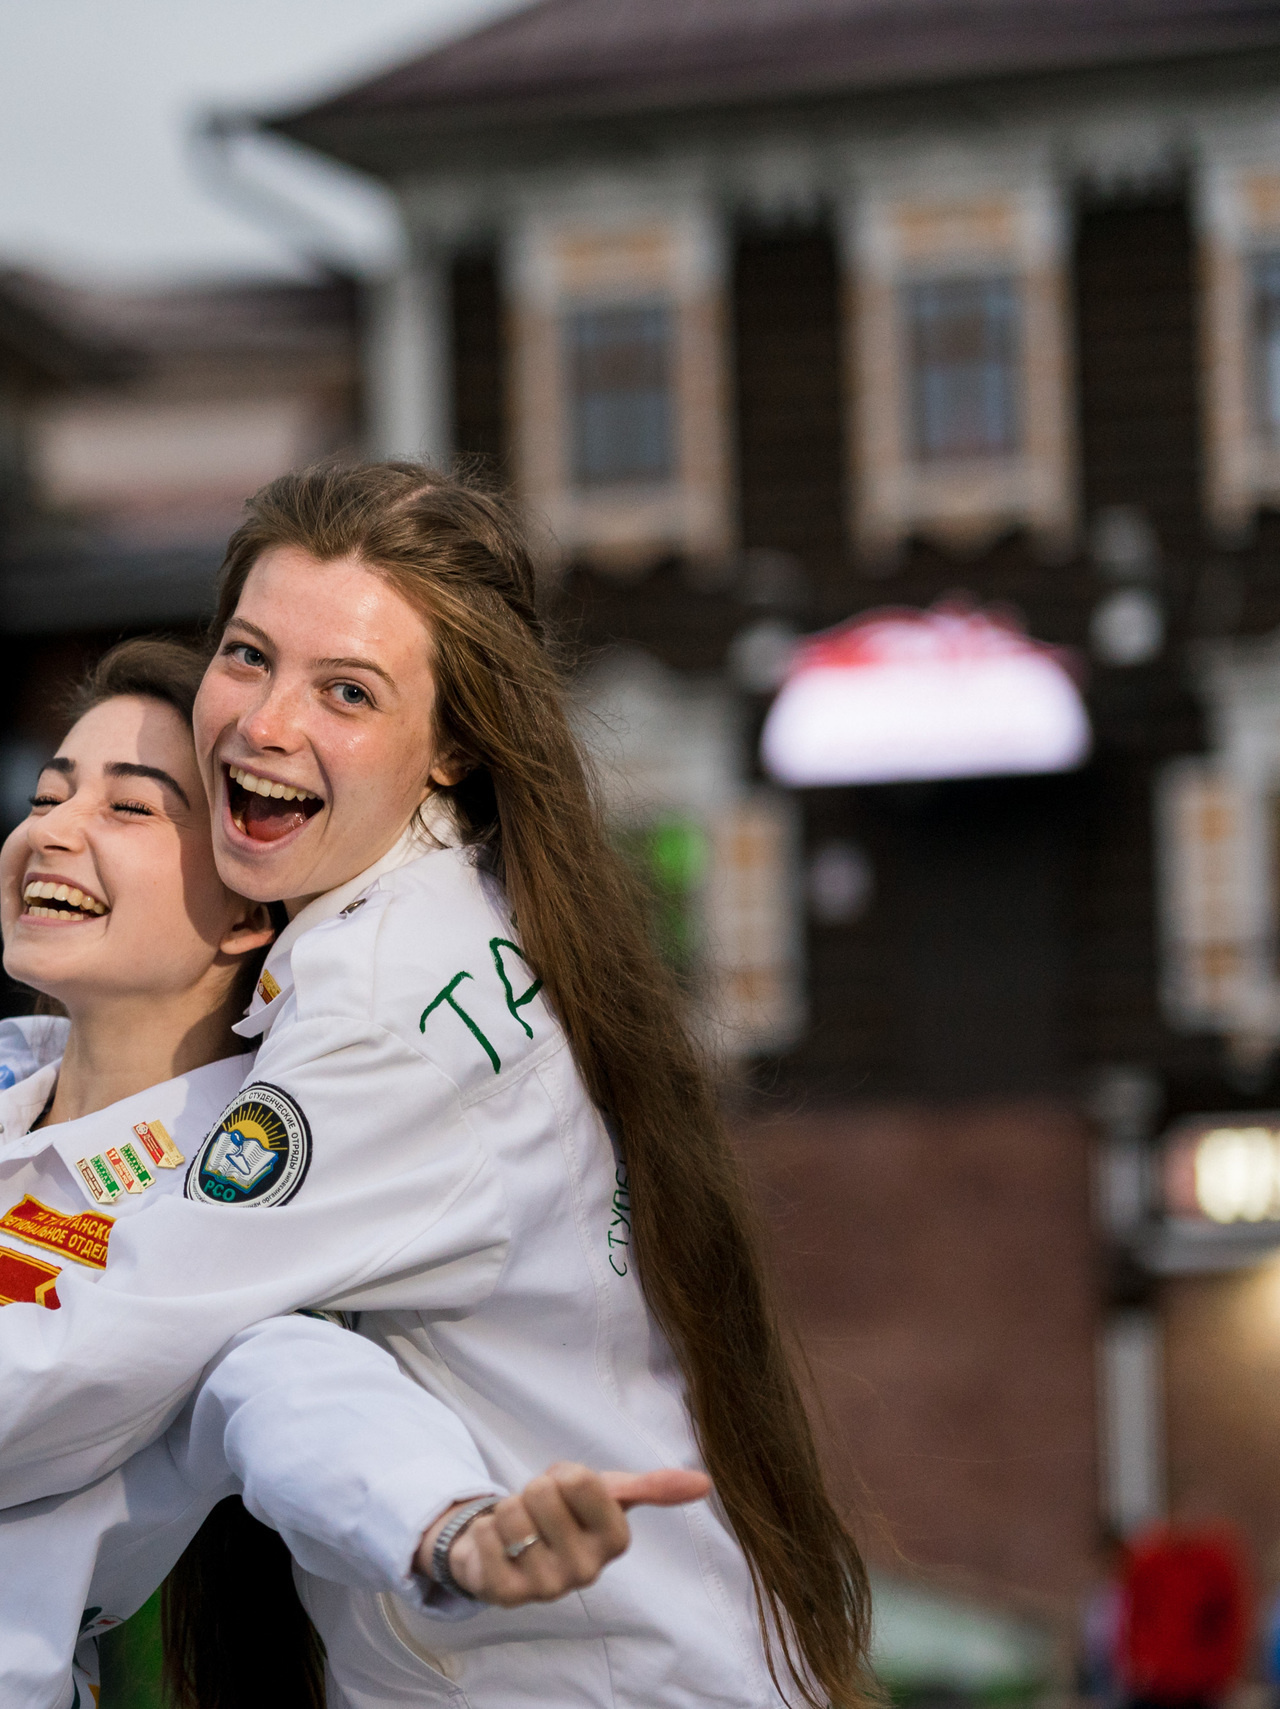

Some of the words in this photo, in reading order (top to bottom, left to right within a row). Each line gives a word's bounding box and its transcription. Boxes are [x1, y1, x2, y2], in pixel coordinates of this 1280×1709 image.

[248, 1091, 296, 1130] СТУДЕНЧЕСКИЕ
[288, 1132, 300, 1170] ОТРЯДЫ
[108, 1149, 120, 1161] 17
[203, 1179, 236, 1202] РСО
